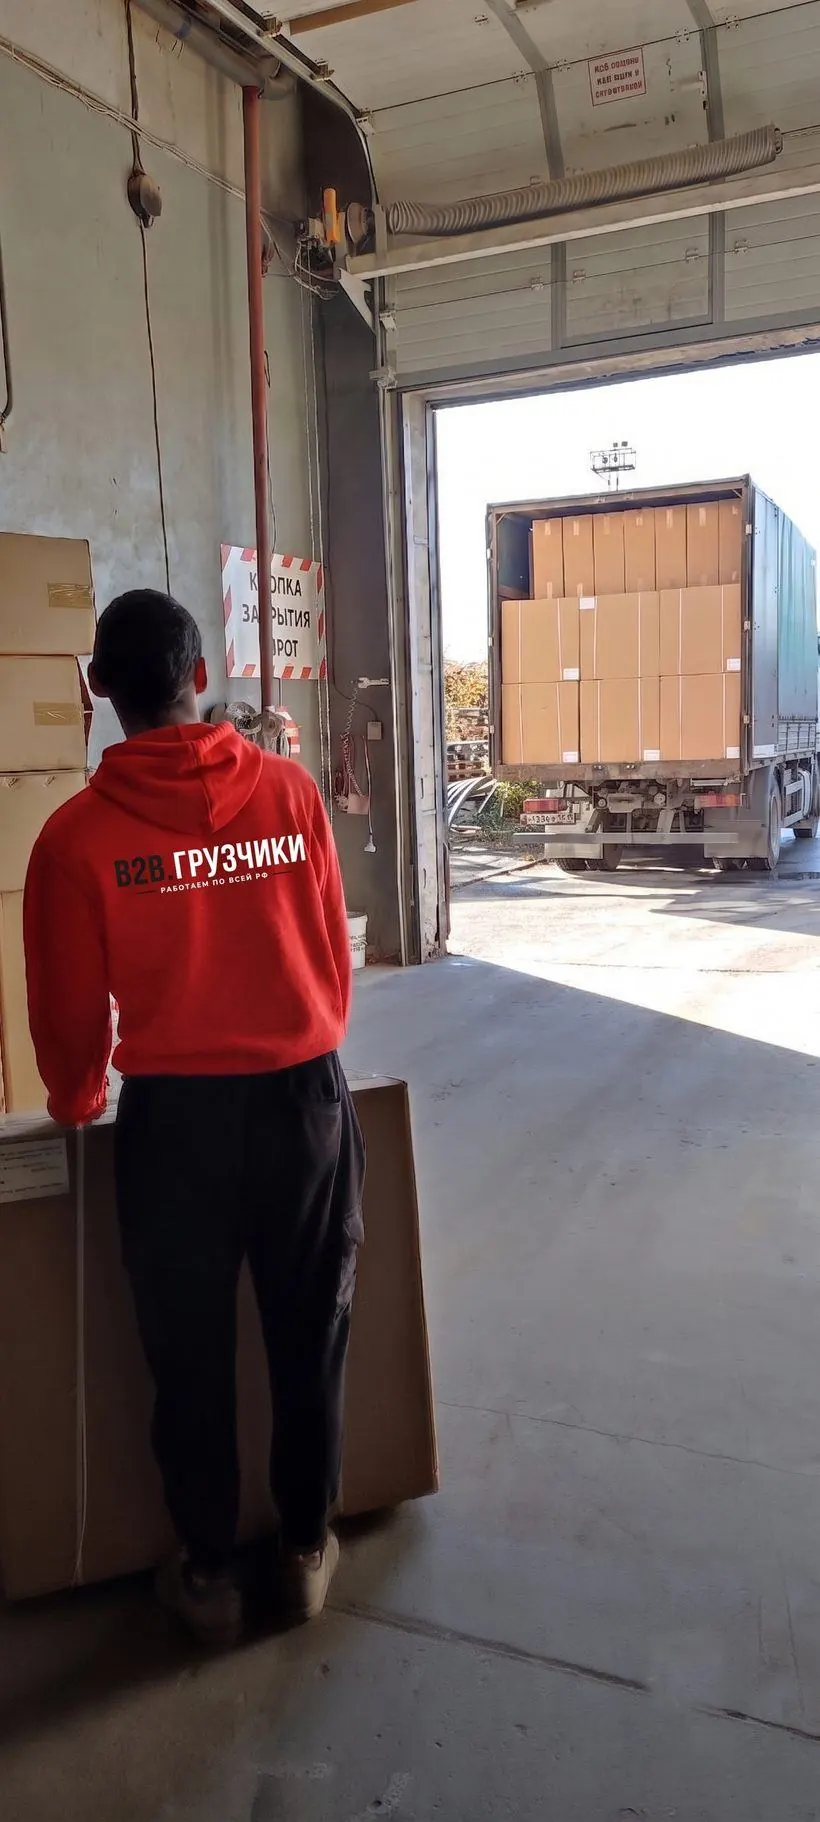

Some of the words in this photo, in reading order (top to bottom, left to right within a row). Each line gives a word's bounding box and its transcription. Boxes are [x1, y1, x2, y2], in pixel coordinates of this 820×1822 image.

[249, 571, 302, 597] КОПКА
[160, 880, 209, 894] РАБОТАЕМ
[212, 878, 226, 886] ПО
[228, 873, 253, 884] ВСЕЙ
[255, 871, 269, 880] РФ
